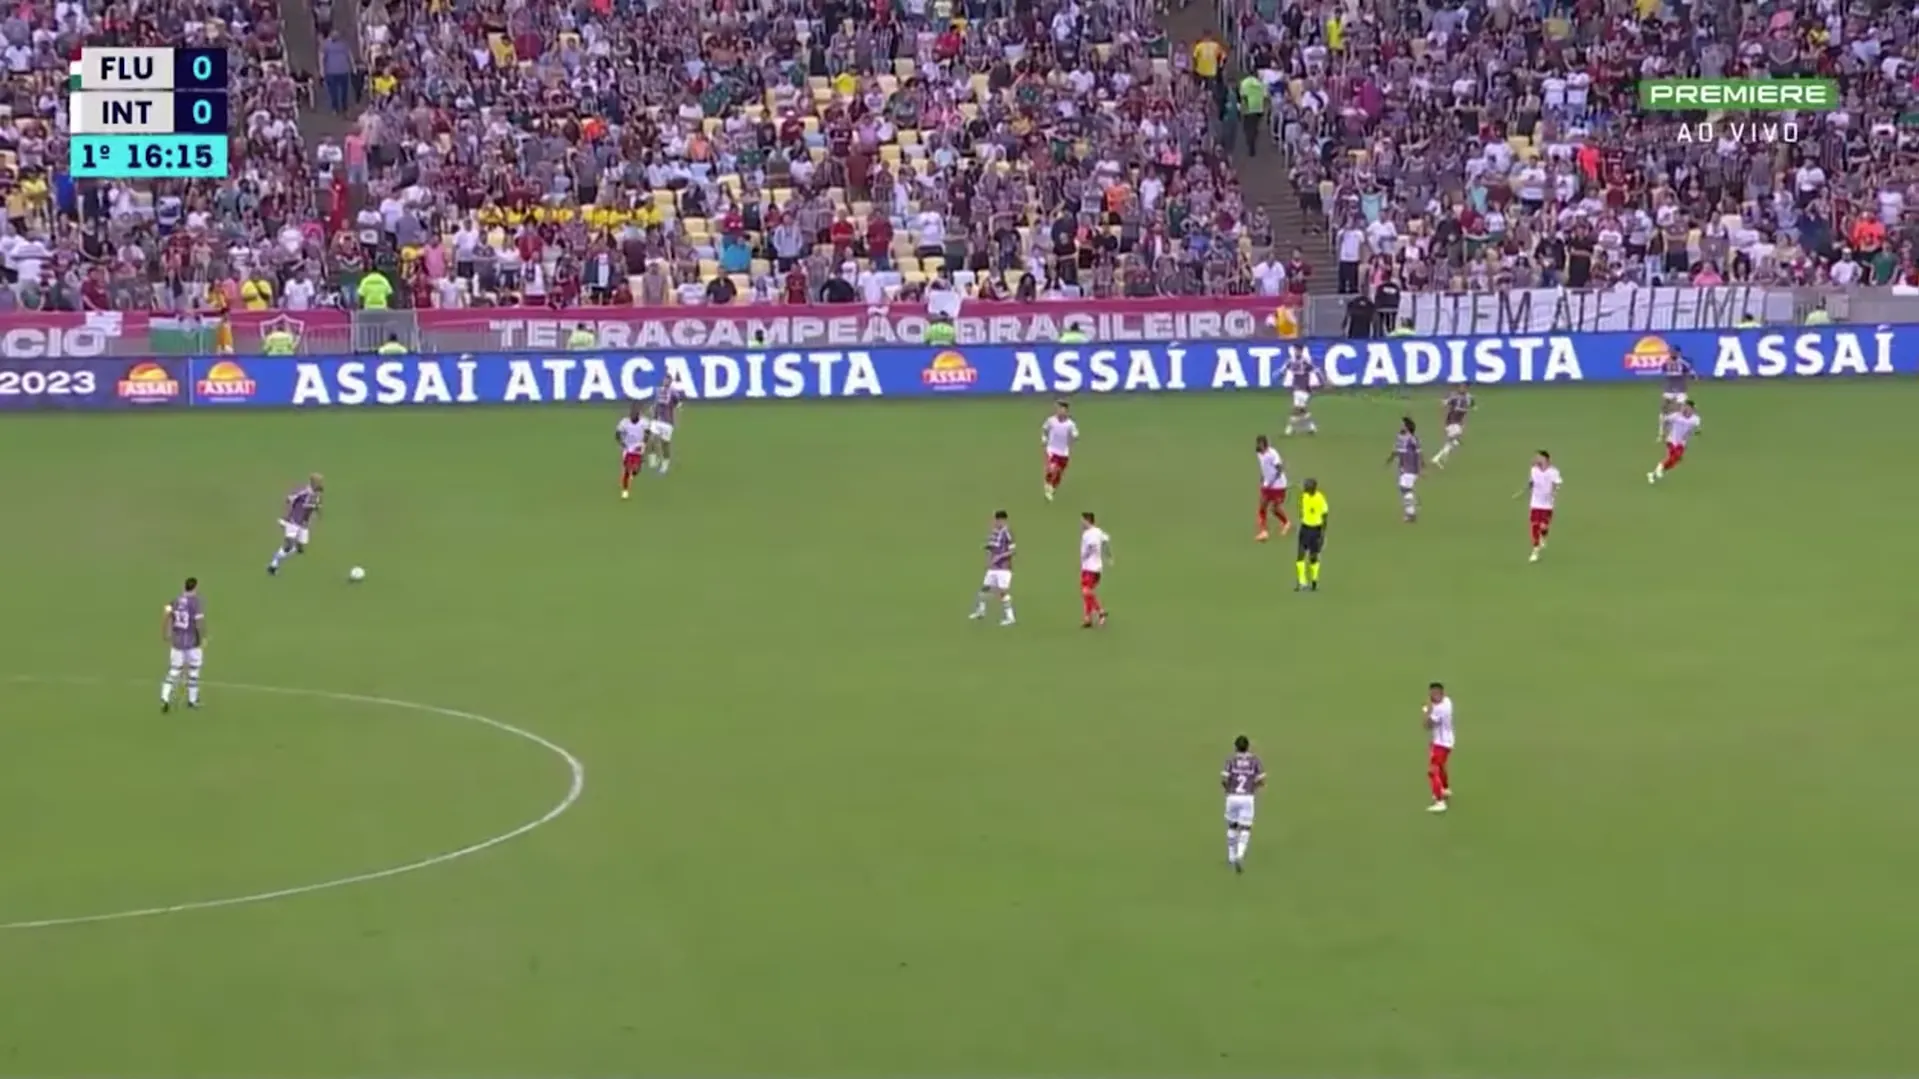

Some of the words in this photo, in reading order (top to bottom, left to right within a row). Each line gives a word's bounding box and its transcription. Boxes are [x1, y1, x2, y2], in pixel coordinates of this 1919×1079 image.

[955, 309, 1256, 344] BRASILEIRO
[1714, 324, 1895, 377] ASSAÍ
[0, 371, 96, 394] 2023
[293, 353, 478, 404] ASSAÍ
[504, 352, 882, 401] ATACADISTA
[1011, 341, 1187, 392] ASSAÍ
